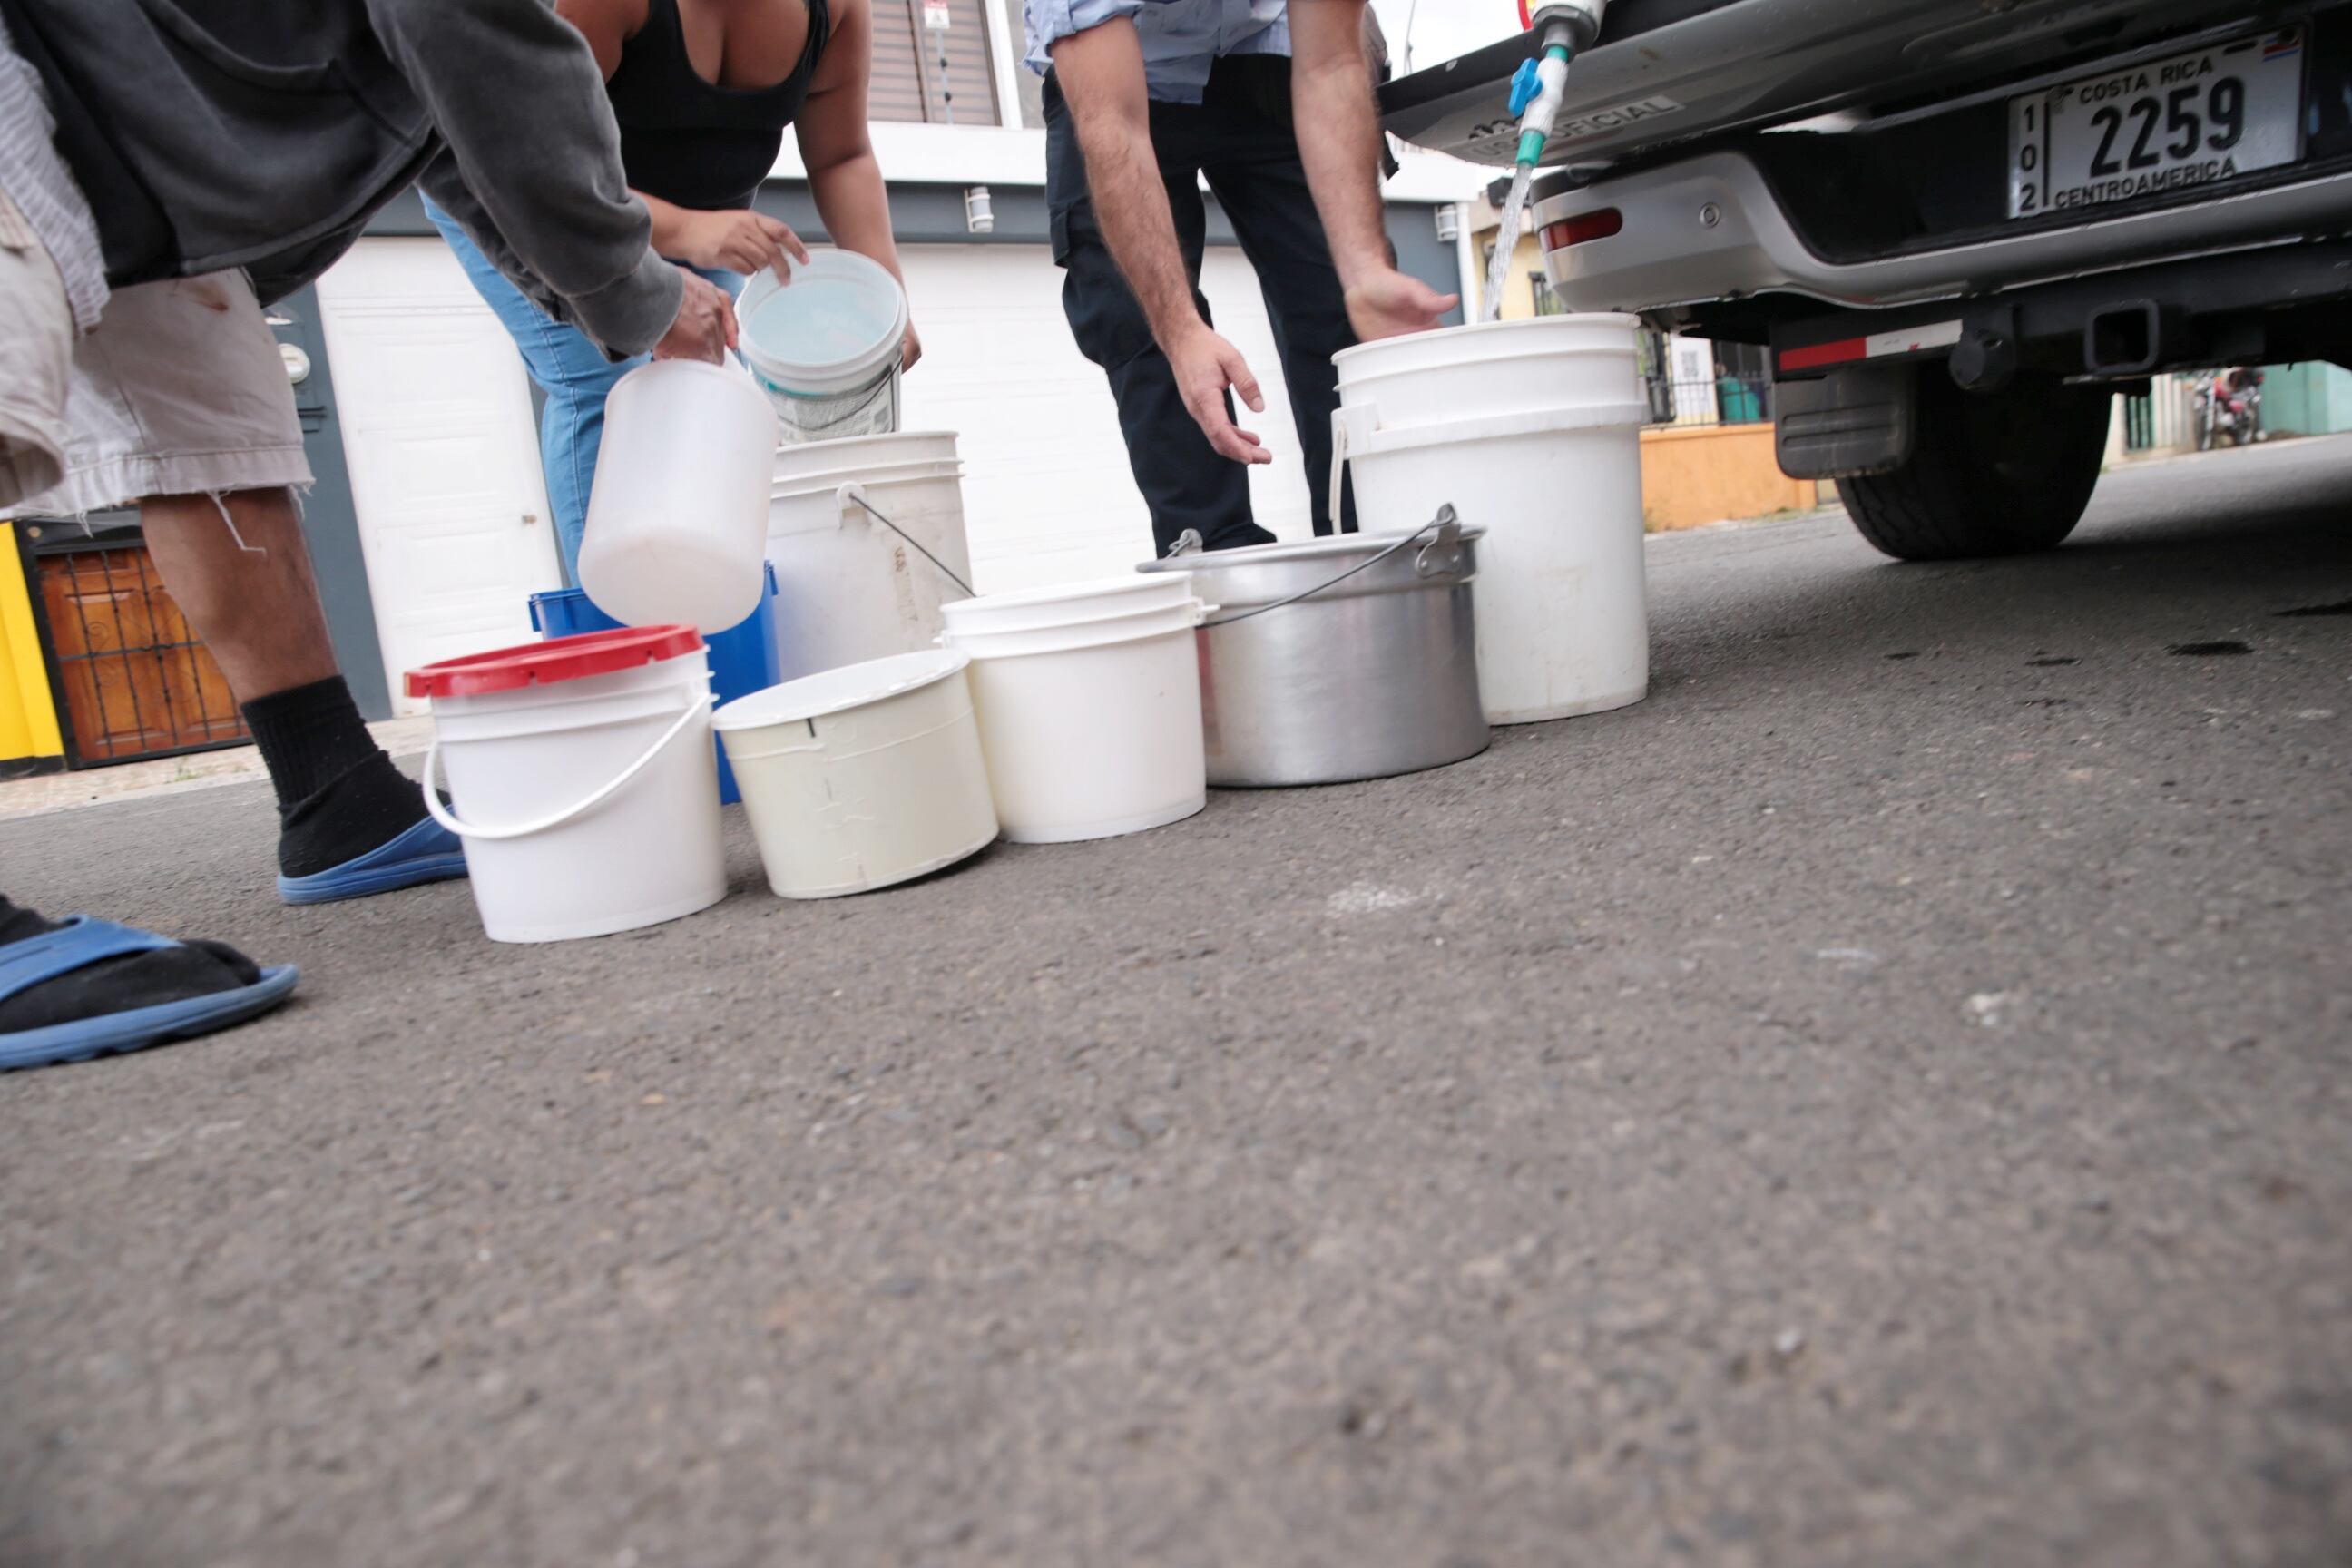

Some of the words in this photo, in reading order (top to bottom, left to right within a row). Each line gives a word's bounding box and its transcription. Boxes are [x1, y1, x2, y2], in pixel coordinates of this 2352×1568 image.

[2079, 73, 2150, 105] COSTA
[2160, 55, 2214, 85] RICA
[2089, 76, 2246, 179] 2259
[2054, 155, 2239, 209] CENTROAMERICA
